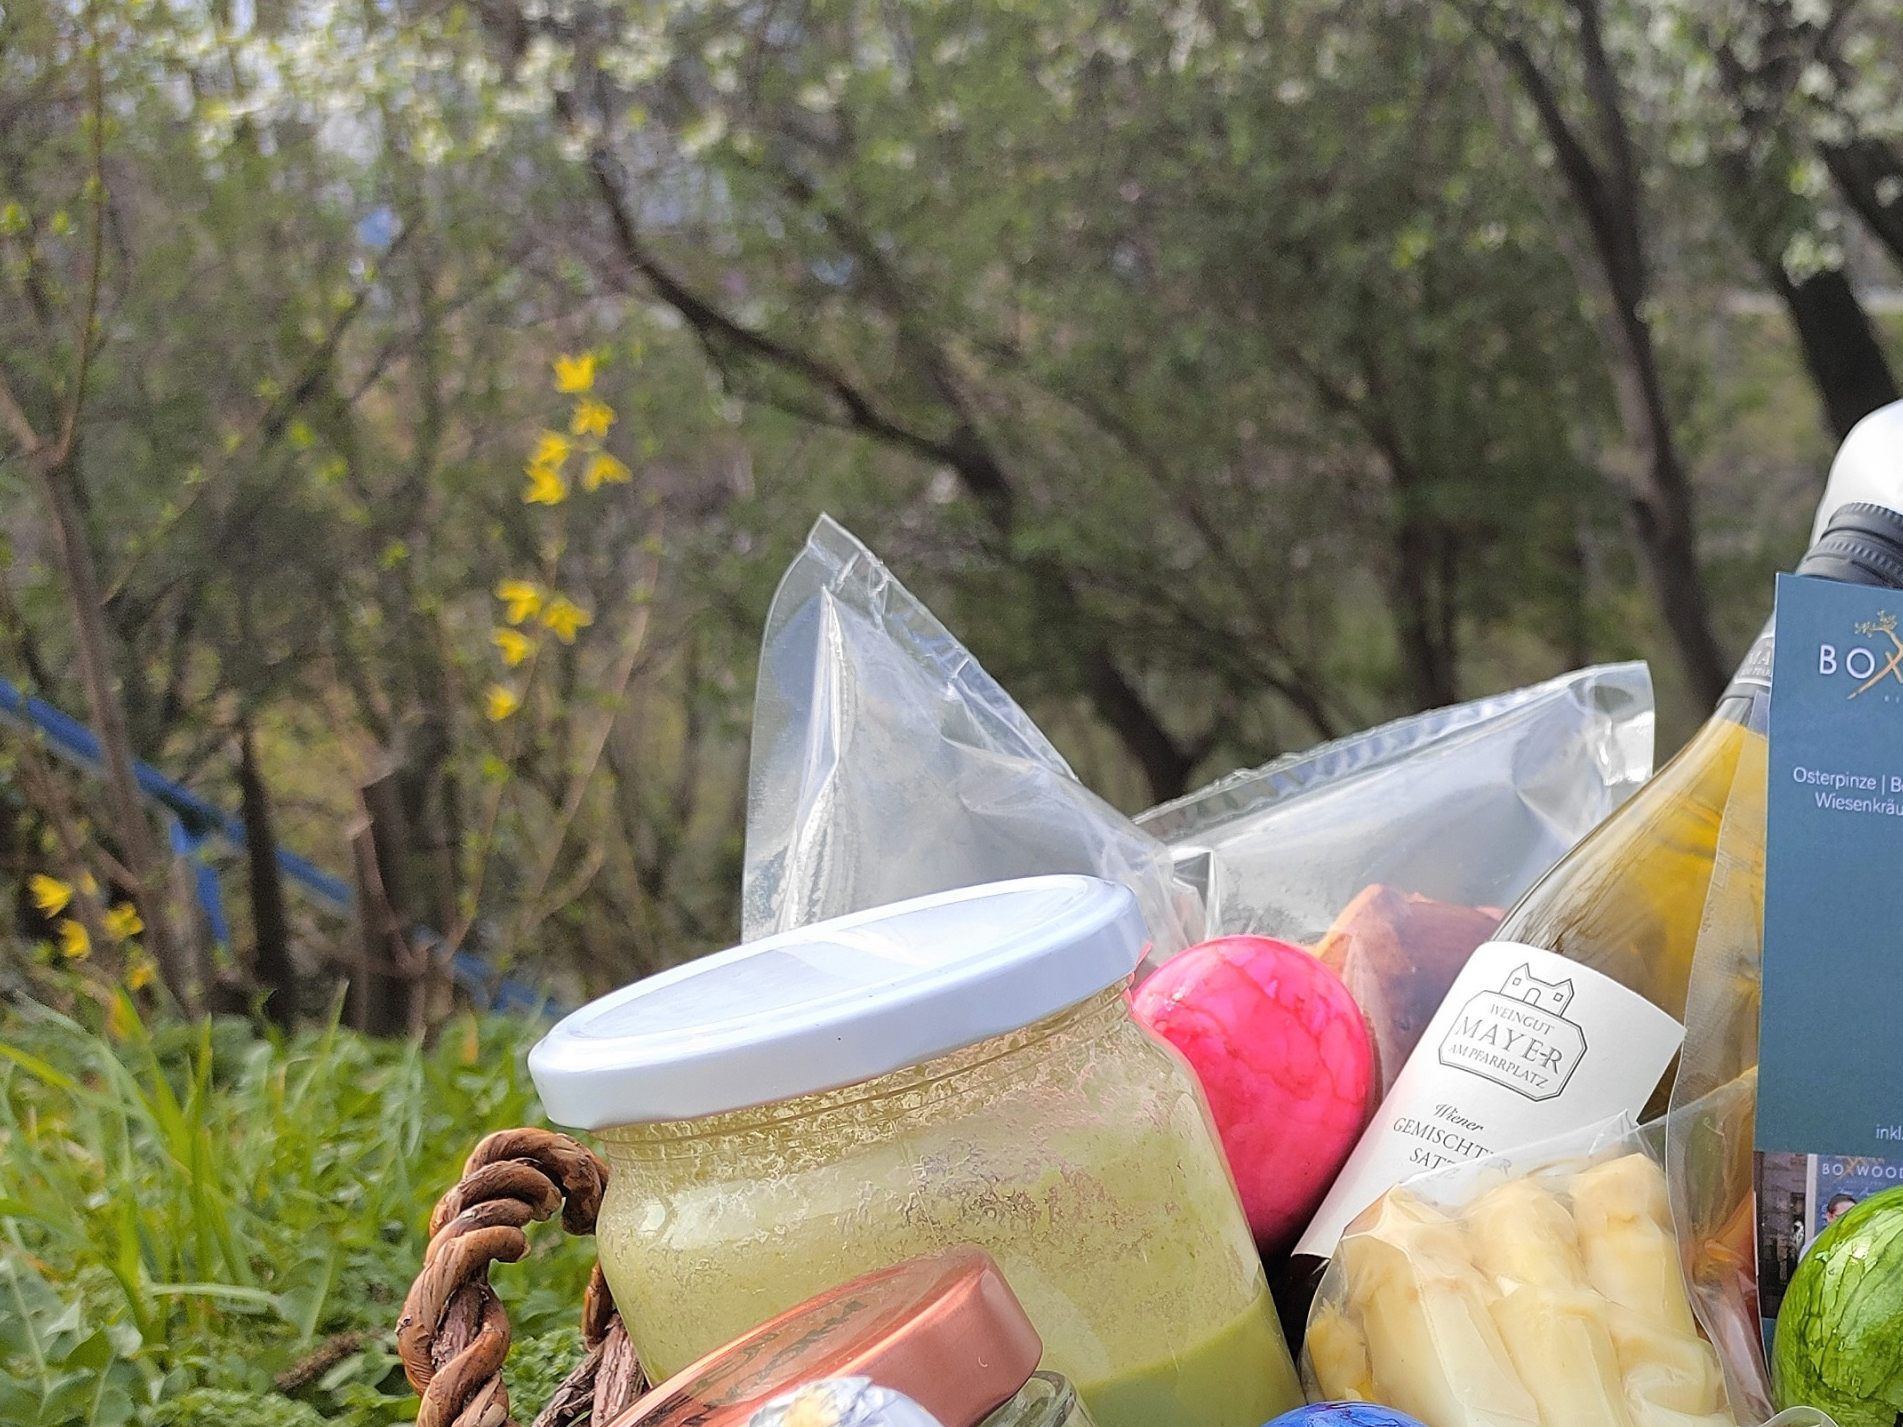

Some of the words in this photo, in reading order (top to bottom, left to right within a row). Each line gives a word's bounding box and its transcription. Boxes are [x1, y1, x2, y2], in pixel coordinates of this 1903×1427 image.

[1792, 766, 1877, 790] Osterpinze
[1490, 1003, 1555, 1036] WEINGUT
[1455, 1015, 1563, 1075] MAYER
[1449, 1043, 1468, 1057] AM
[1467, 1046, 1549, 1090] PFARRPLATZ
[1433, 1103, 1484, 1131] Wiener
